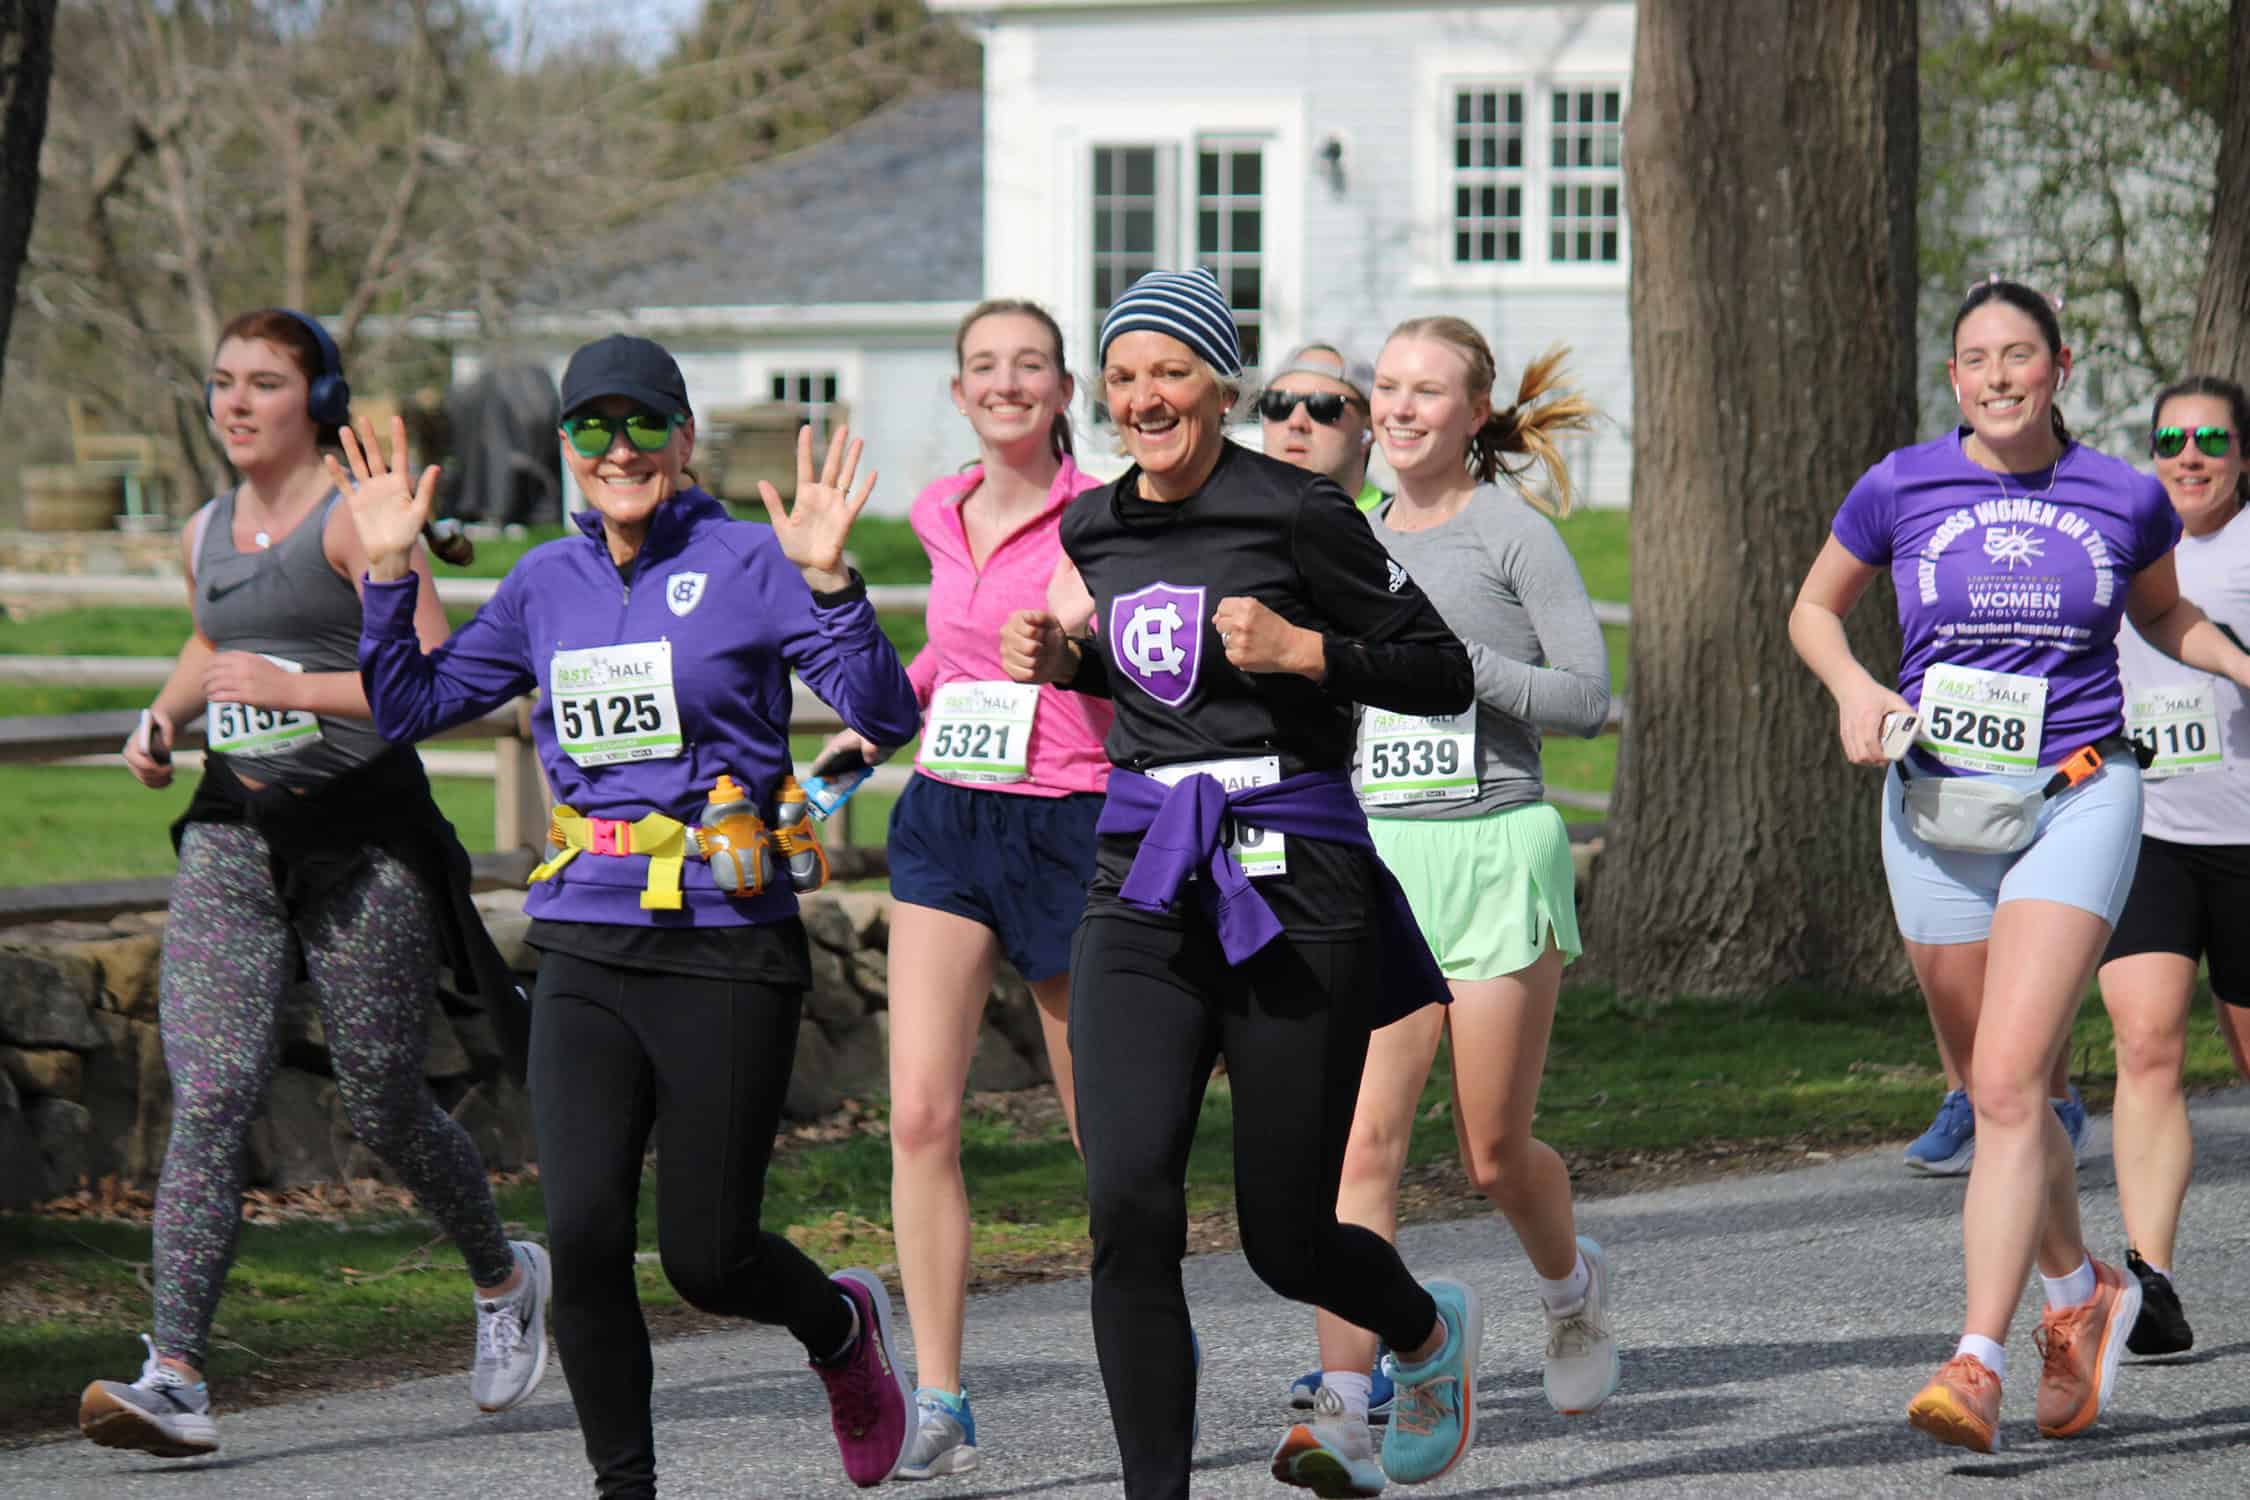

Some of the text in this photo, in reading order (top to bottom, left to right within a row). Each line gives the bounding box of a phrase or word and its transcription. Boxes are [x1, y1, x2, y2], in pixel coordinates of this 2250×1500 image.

[1974, 499, 2059, 528] WOMEN
[2057, 511, 2091, 539] ON
[1968, 583, 2061, 593] FIFTY YEARS OF
[1968, 592, 2061, 610] WOMEN
[1970, 608, 2060, 619] AT HOLY CROSS
[609, 662, 655, 679] HALF
[983, 696, 1018, 711] HALF
[1988, 688, 2032, 703] HALF
[562, 693, 662, 739] 5125
[1930, 706, 2026, 752] 5268
[933, 723, 1010, 760] 5321
[1372, 738, 1459, 778] 5339
